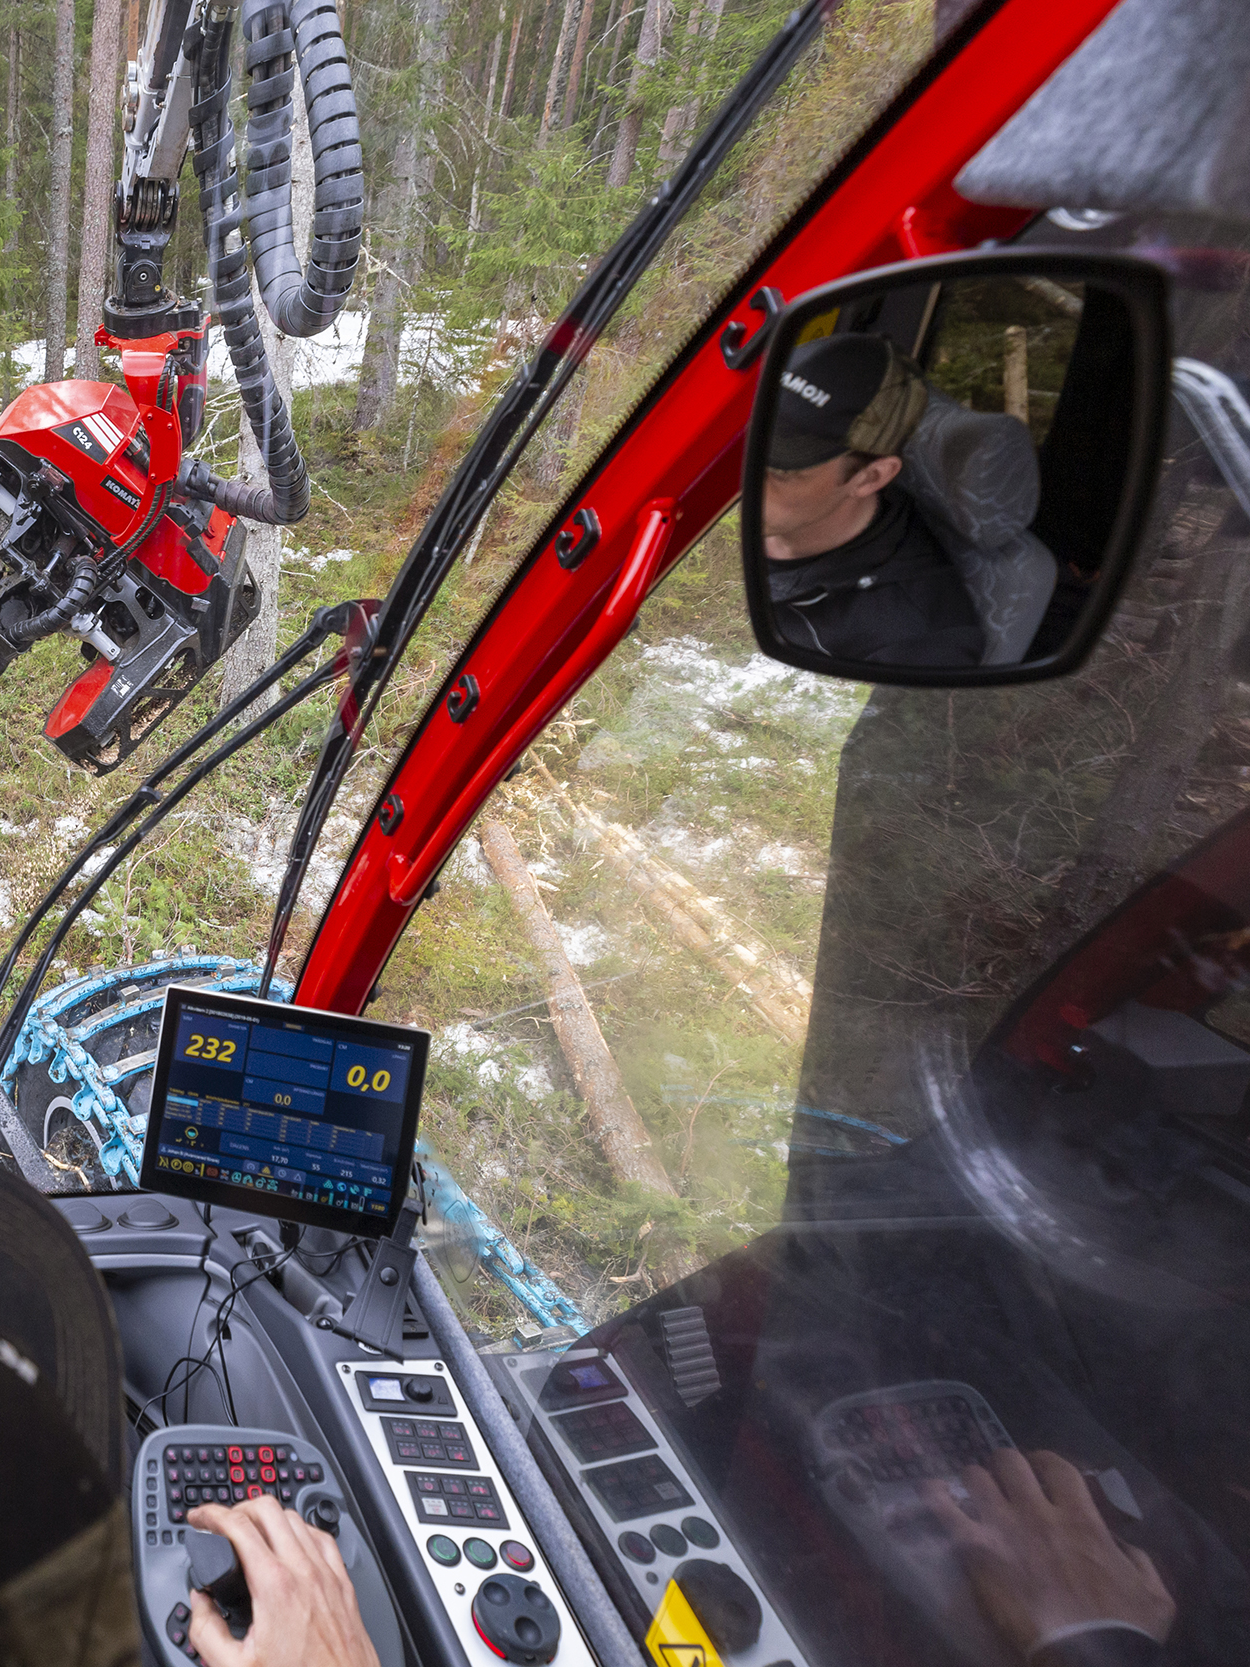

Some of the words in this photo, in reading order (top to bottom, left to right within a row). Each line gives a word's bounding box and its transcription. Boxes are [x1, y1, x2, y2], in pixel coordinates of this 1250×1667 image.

[72, 426, 93, 450] C124
[185, 1034, 236, 1063] 232
[346, 1065, 392, 1092] 0,0
[274, 1093, 292, 1106] 0,0
[271, 1154, 289, 1165] 17,70
[311, 1163, 321, 1172] 55
[340, 1169, 353, 1178] 215
[371, 1176, 387, 1186] 0,32
